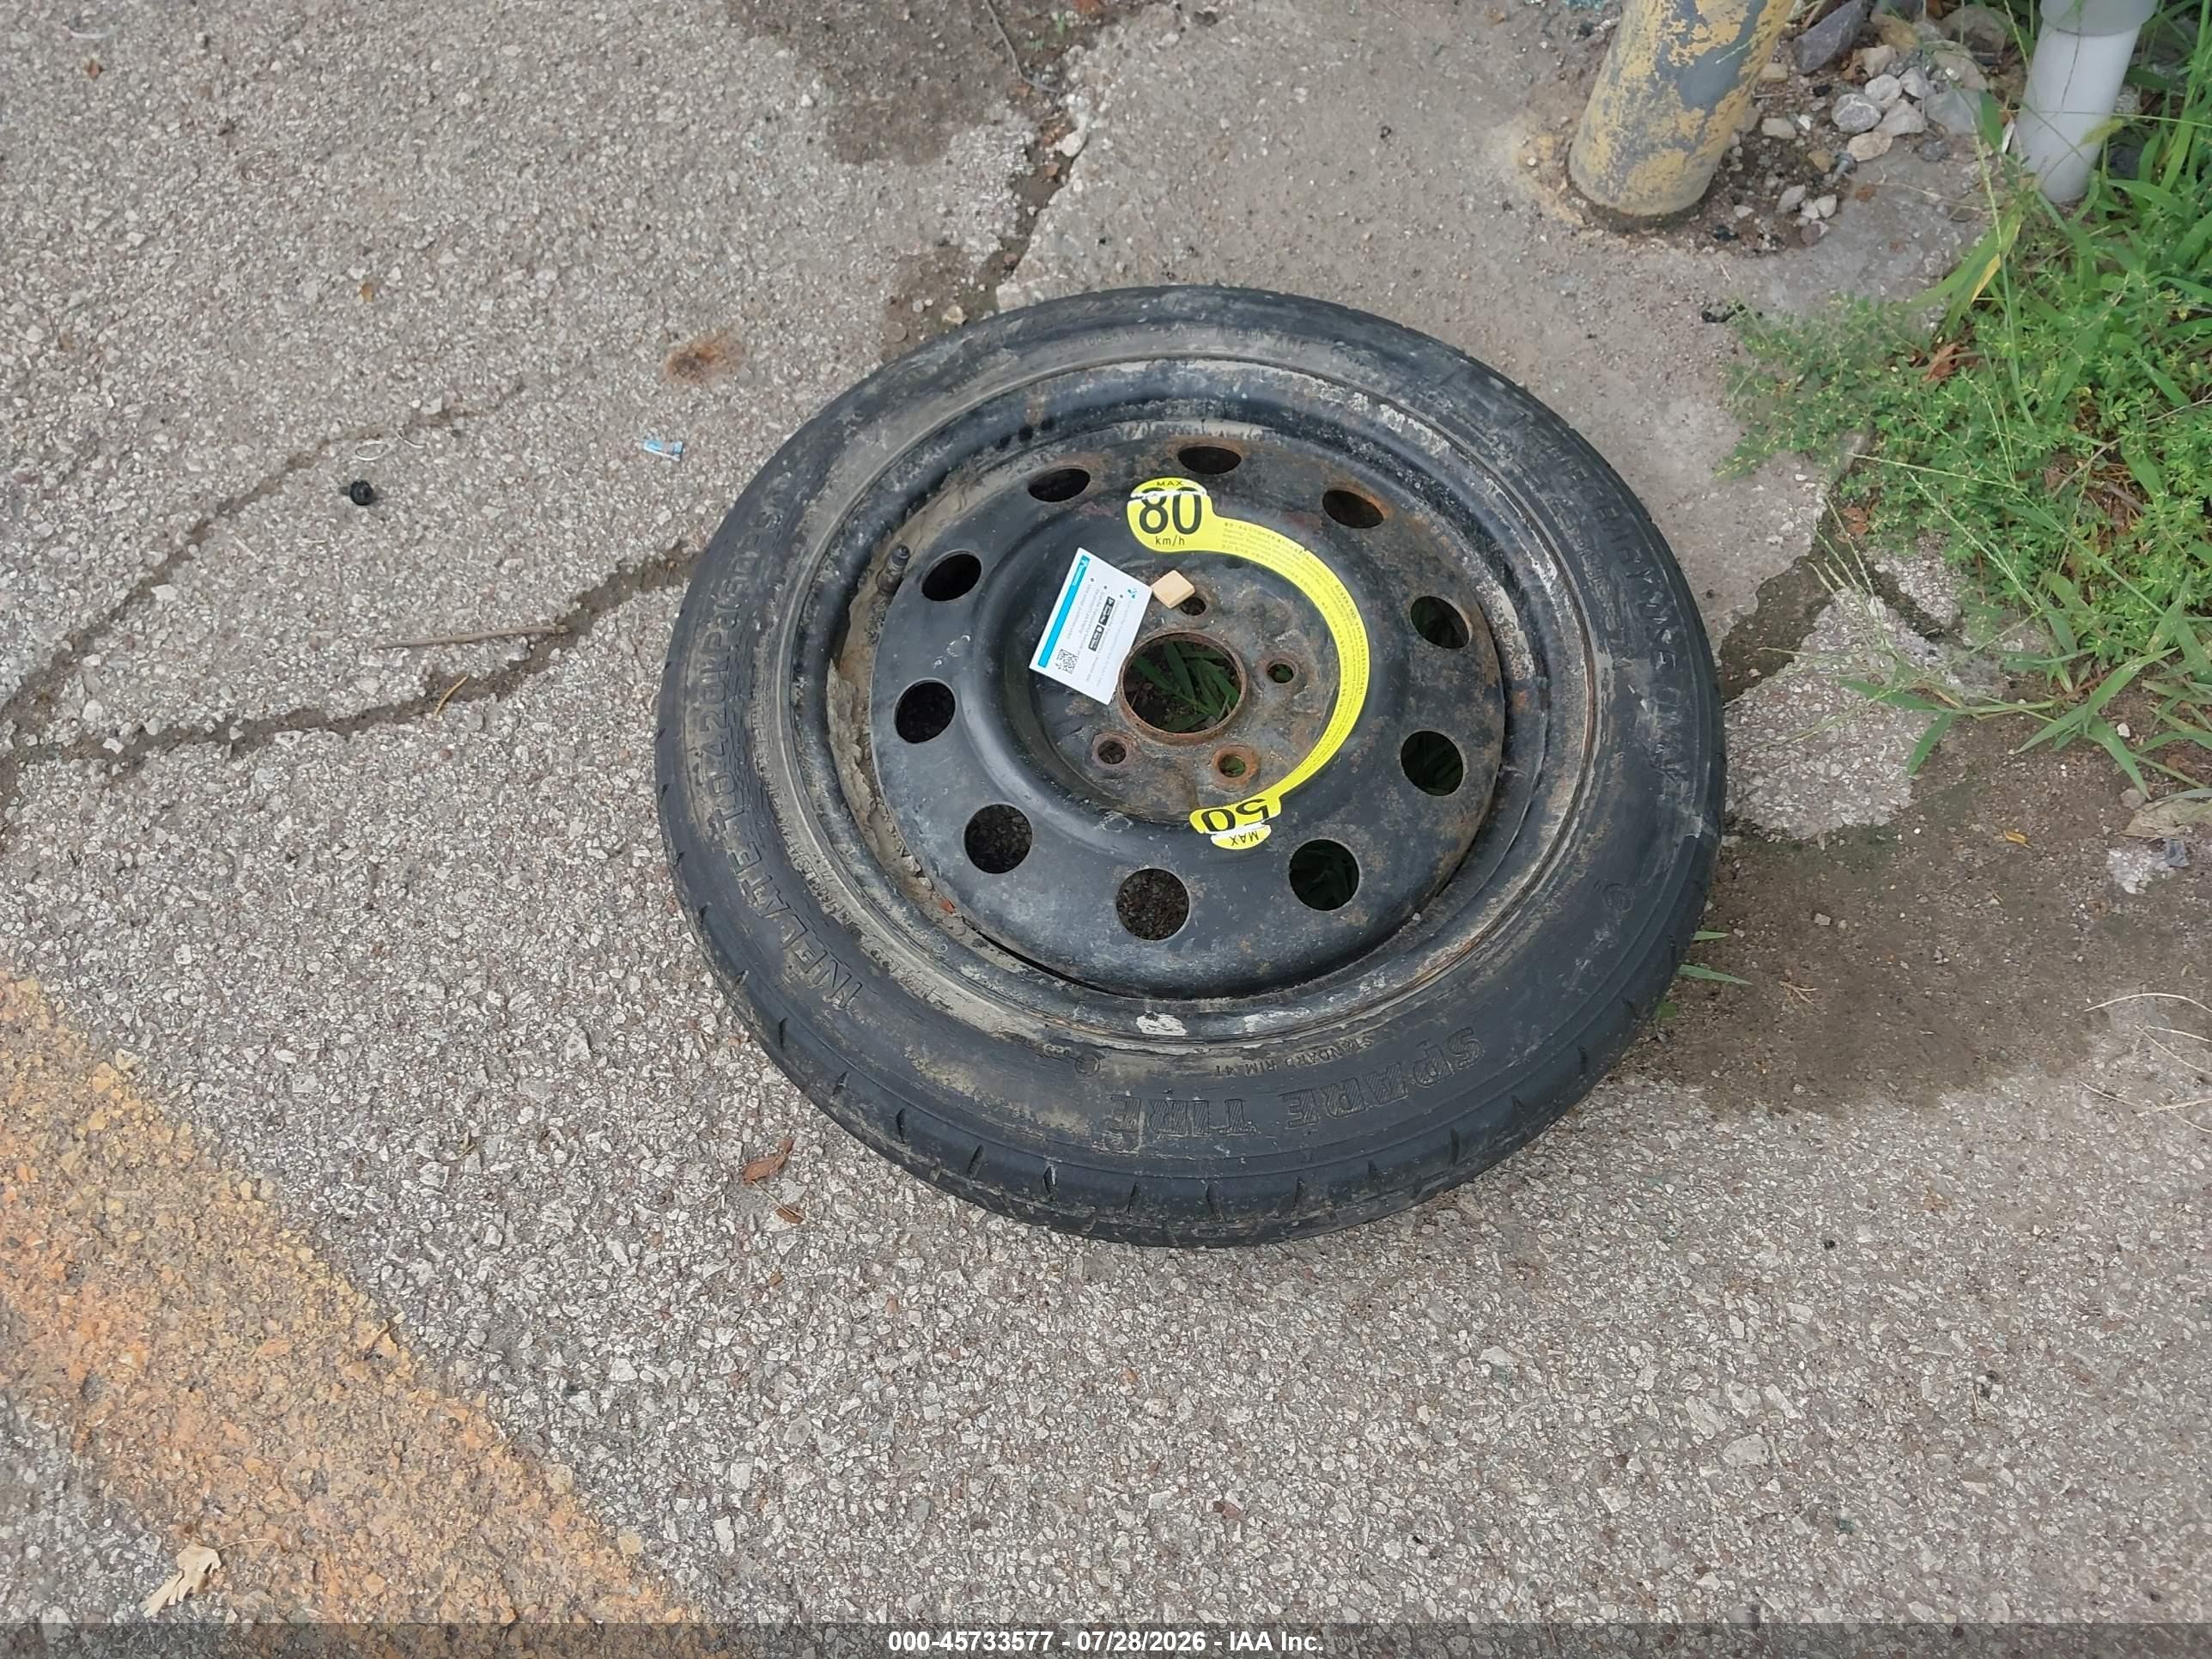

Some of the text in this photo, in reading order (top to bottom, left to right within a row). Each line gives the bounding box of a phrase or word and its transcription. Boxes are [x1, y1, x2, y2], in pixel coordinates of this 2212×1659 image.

[1139, 487, 1202, 535] 80
[1155, 535, 1185, 546] km/h
[708, 775, 746, 830] TO
[1201, 799, 1270, 832] 50
[1230, 830, 1259, 846] MAX
[730, 841, 863, 1009] INFLATE
[1285, 1036, 1373, 1067] STANDARD
[1113, 1026, 1486, 1138] SPARE TIRE
[1245, 1060, 1279, 1078] RIM
